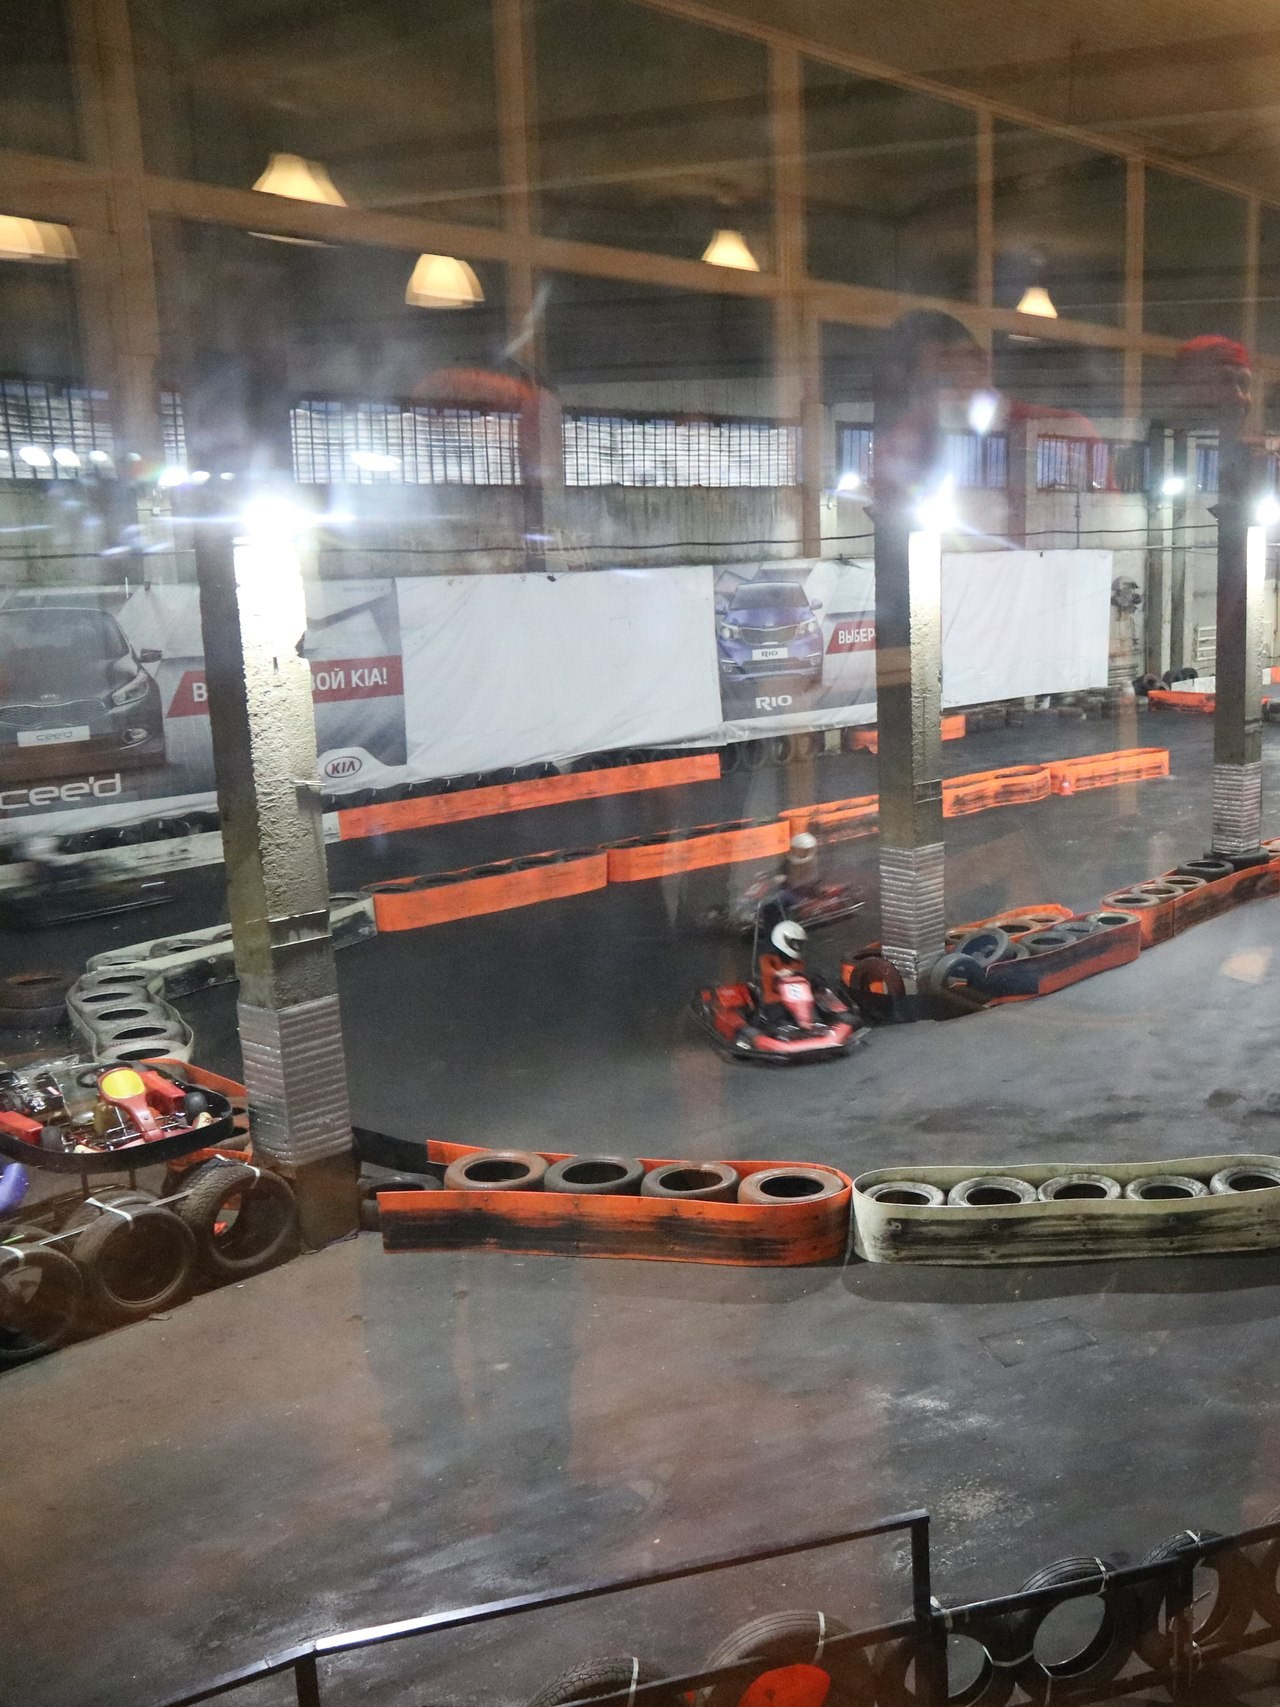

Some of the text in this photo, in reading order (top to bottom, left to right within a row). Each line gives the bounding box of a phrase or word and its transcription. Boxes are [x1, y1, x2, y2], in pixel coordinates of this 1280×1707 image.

[351, 667, 387, 688] KIA!
[755, 695, 793, 711] RIO
[0, 773, 122, 810] cee'd
